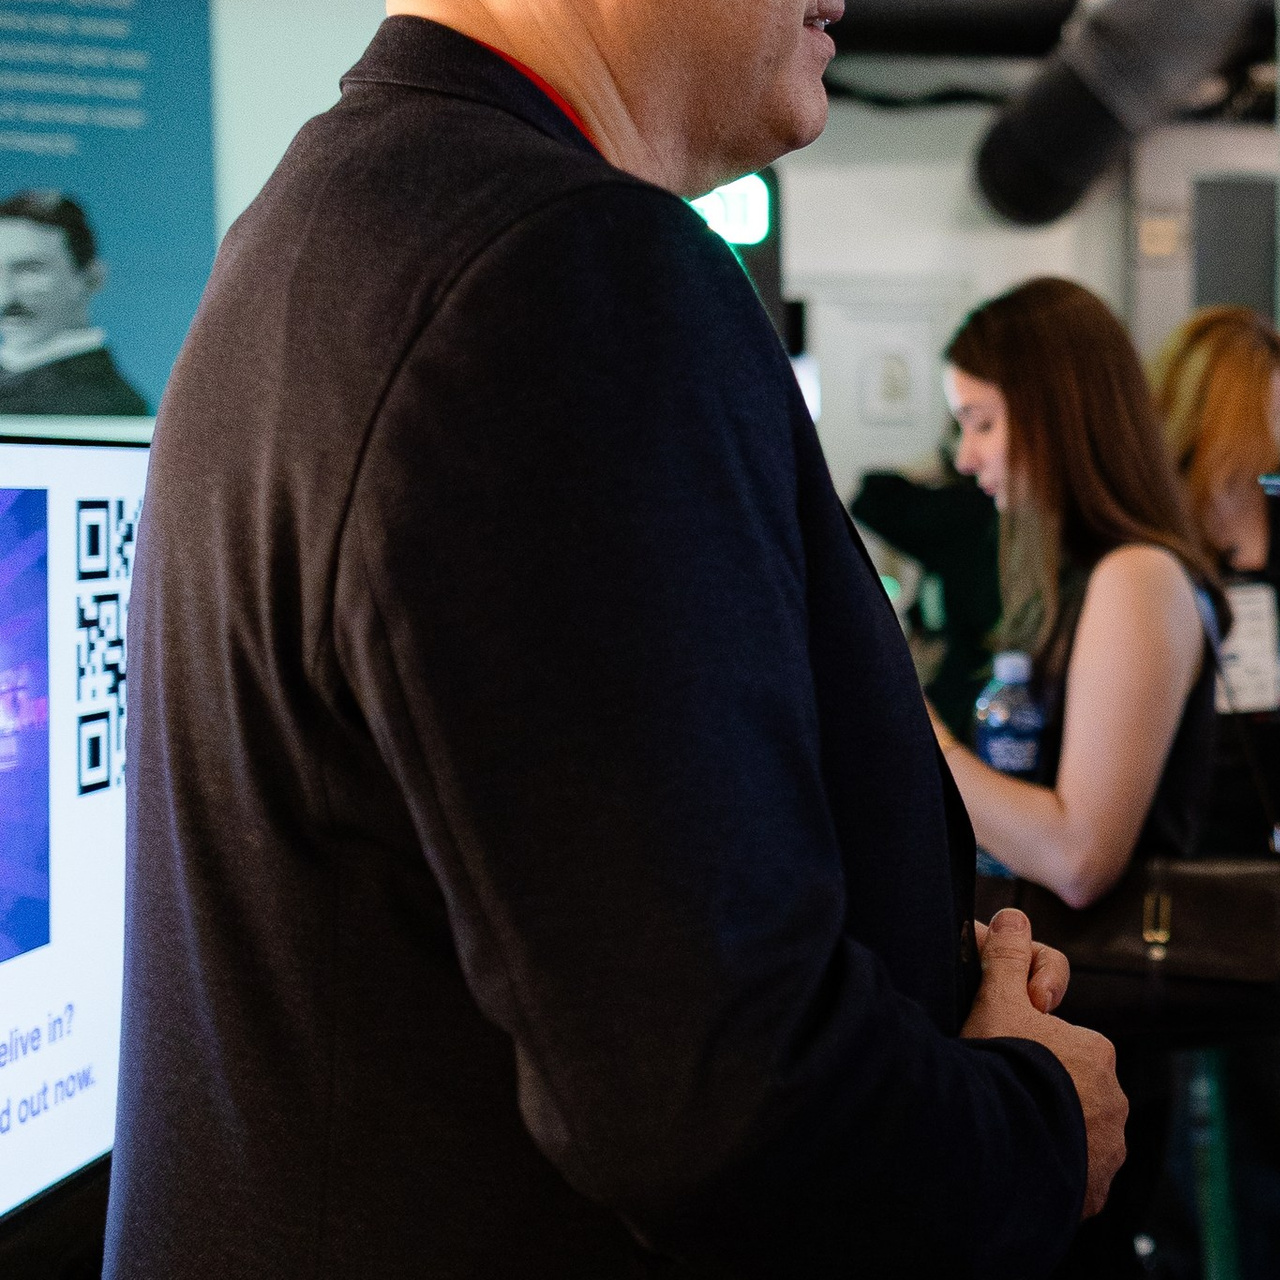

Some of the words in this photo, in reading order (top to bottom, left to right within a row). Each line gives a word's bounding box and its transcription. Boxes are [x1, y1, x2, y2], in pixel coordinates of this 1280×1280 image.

[47, 1003, 75, 1043] in?
[18, 1082, 48, 1123] out
[54, 1064, 96, 1104] now.
